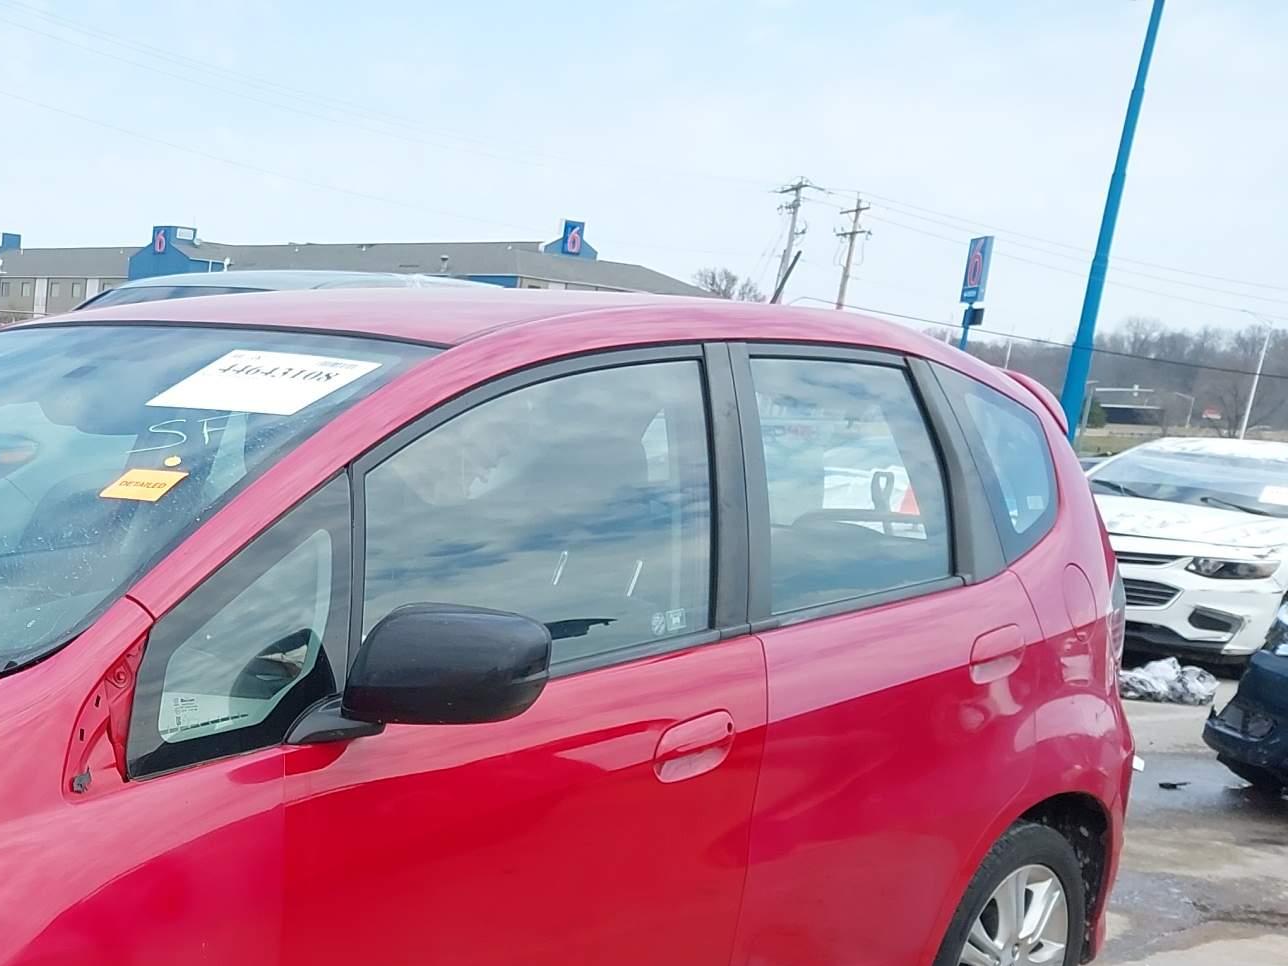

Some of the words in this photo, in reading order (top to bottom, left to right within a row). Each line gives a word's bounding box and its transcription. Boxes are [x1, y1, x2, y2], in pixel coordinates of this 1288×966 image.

[154, 229, 166, 253] 6
[567, 226, 581, 253] 6
[968, 239, 984, 287] 6
[218, 362, 339, 382] 44643108
[119, 480, 167, 489] DETAILED
